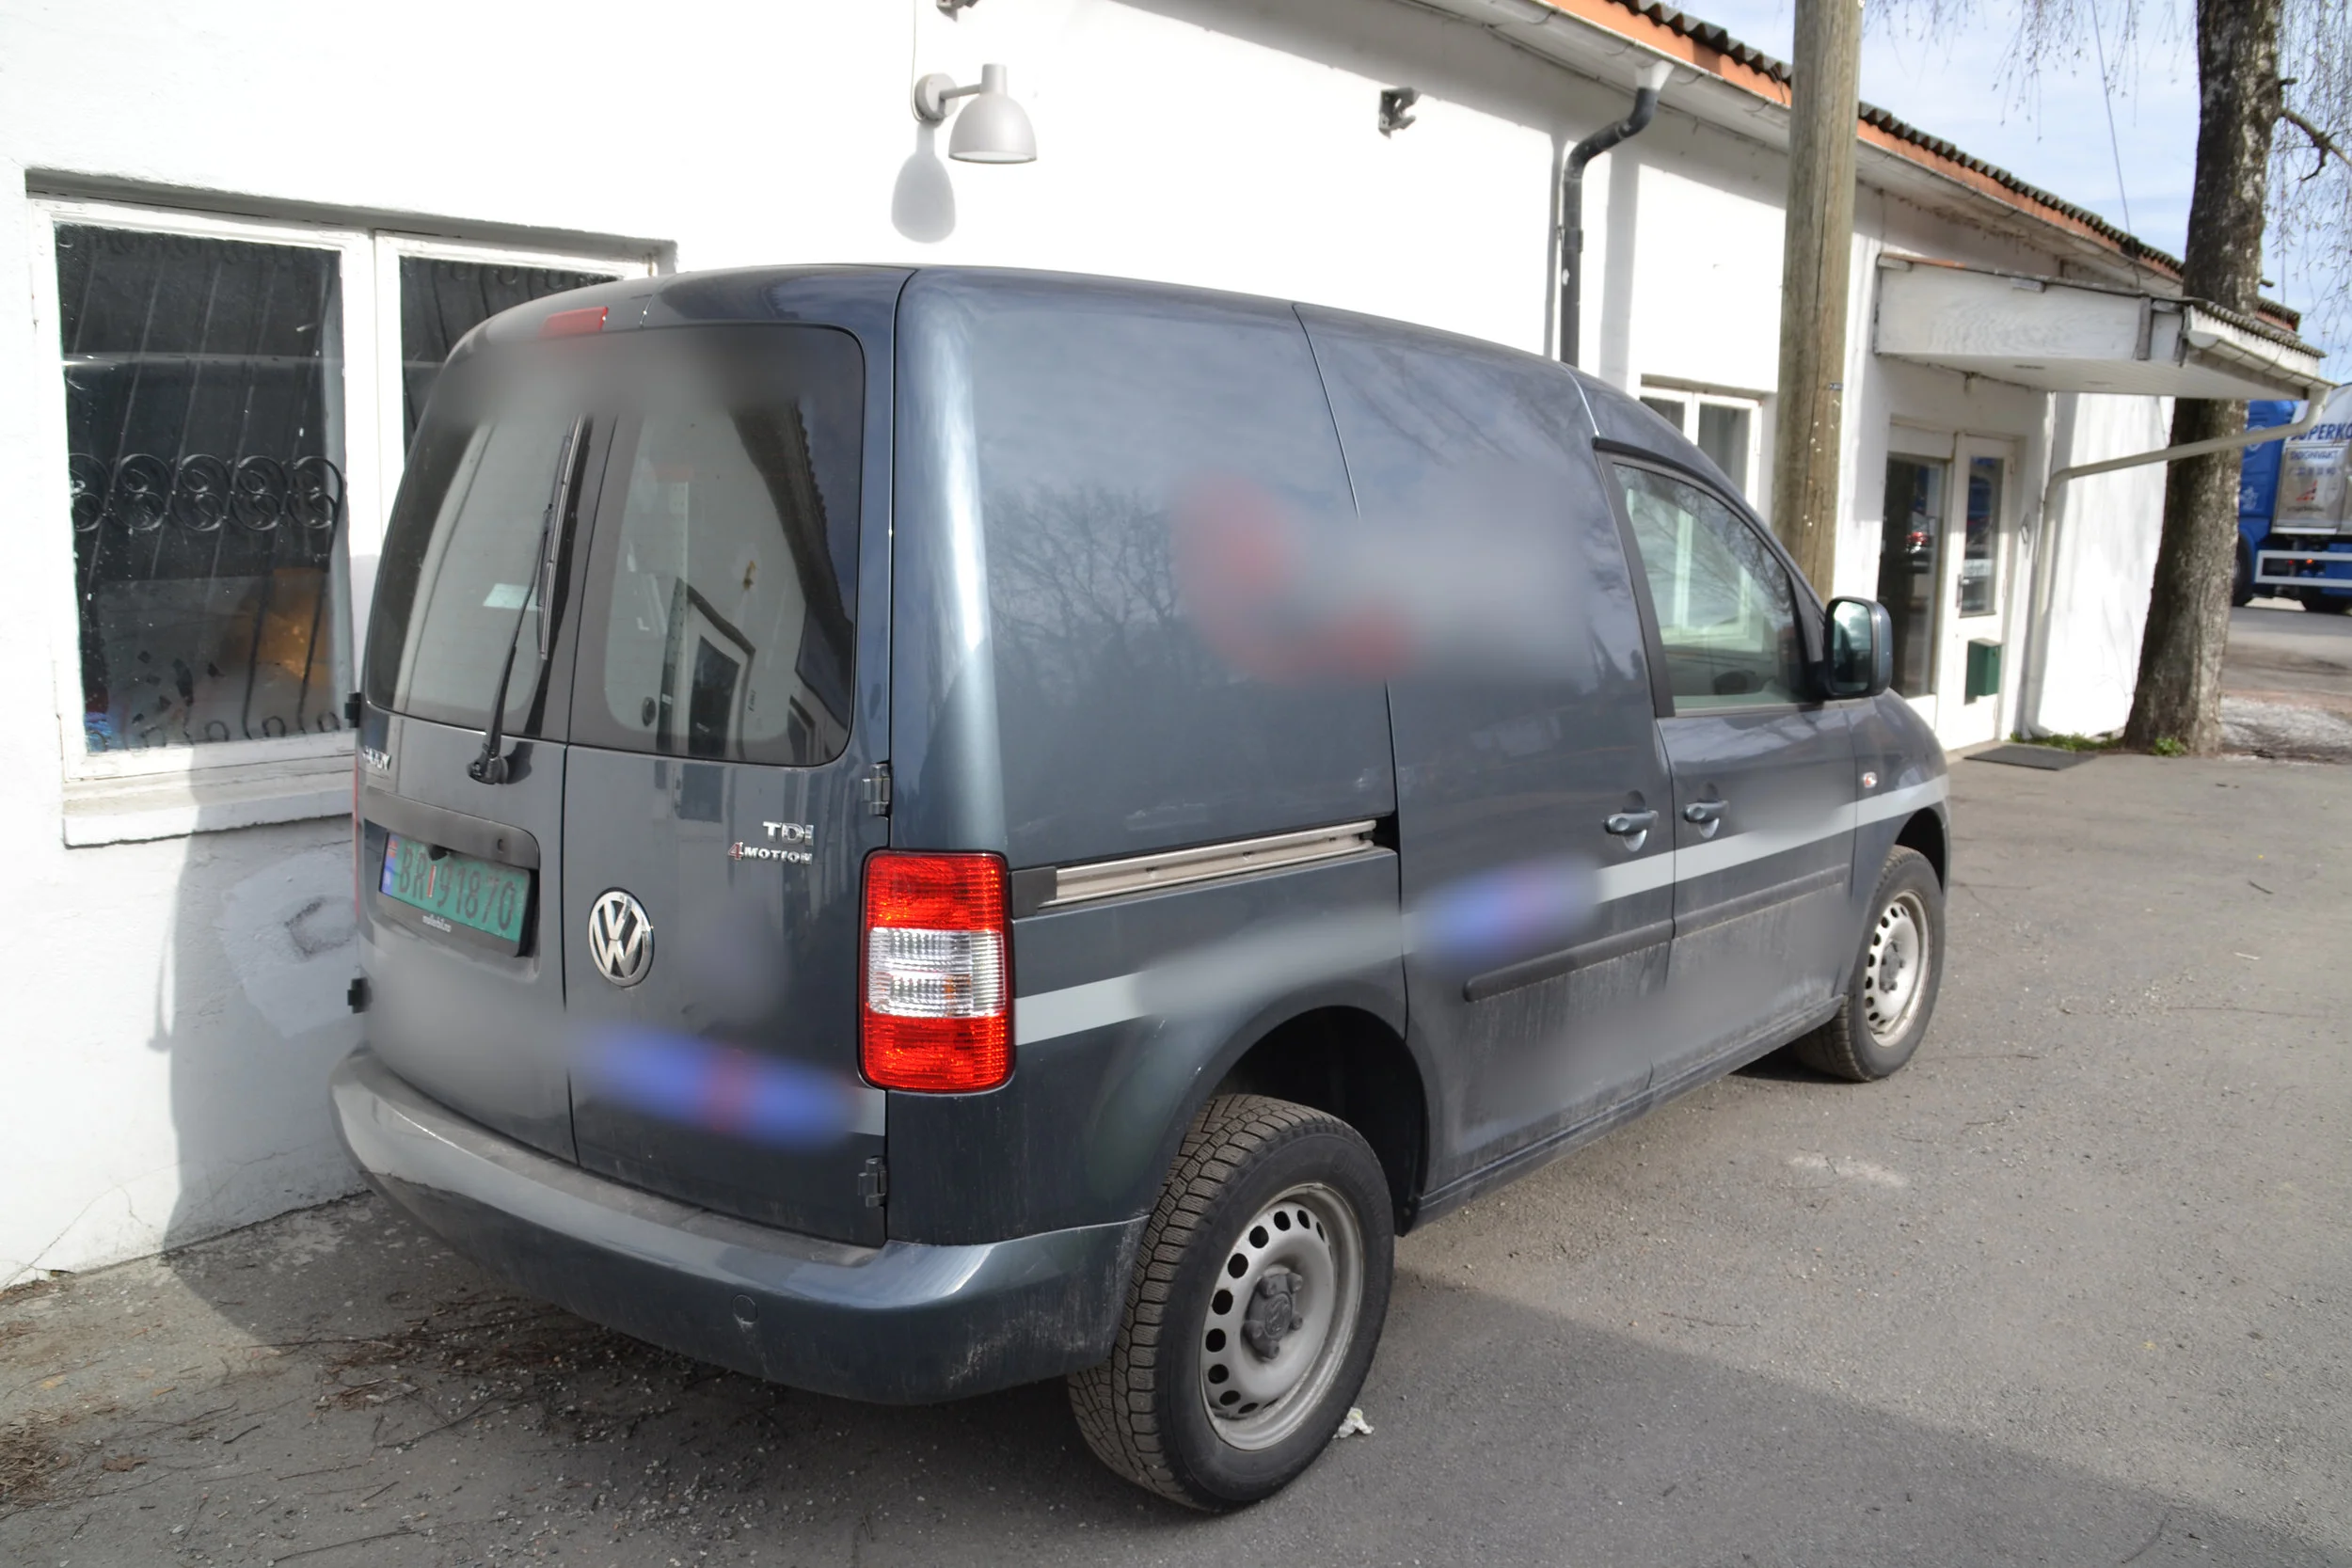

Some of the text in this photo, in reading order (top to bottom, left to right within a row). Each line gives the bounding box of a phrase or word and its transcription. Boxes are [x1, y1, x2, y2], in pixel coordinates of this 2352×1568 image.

[762, 821, 815, 847] TDI
[728, 841, 813, 865] 4MOTION
[399, 847, 516, 931] BR 91870
